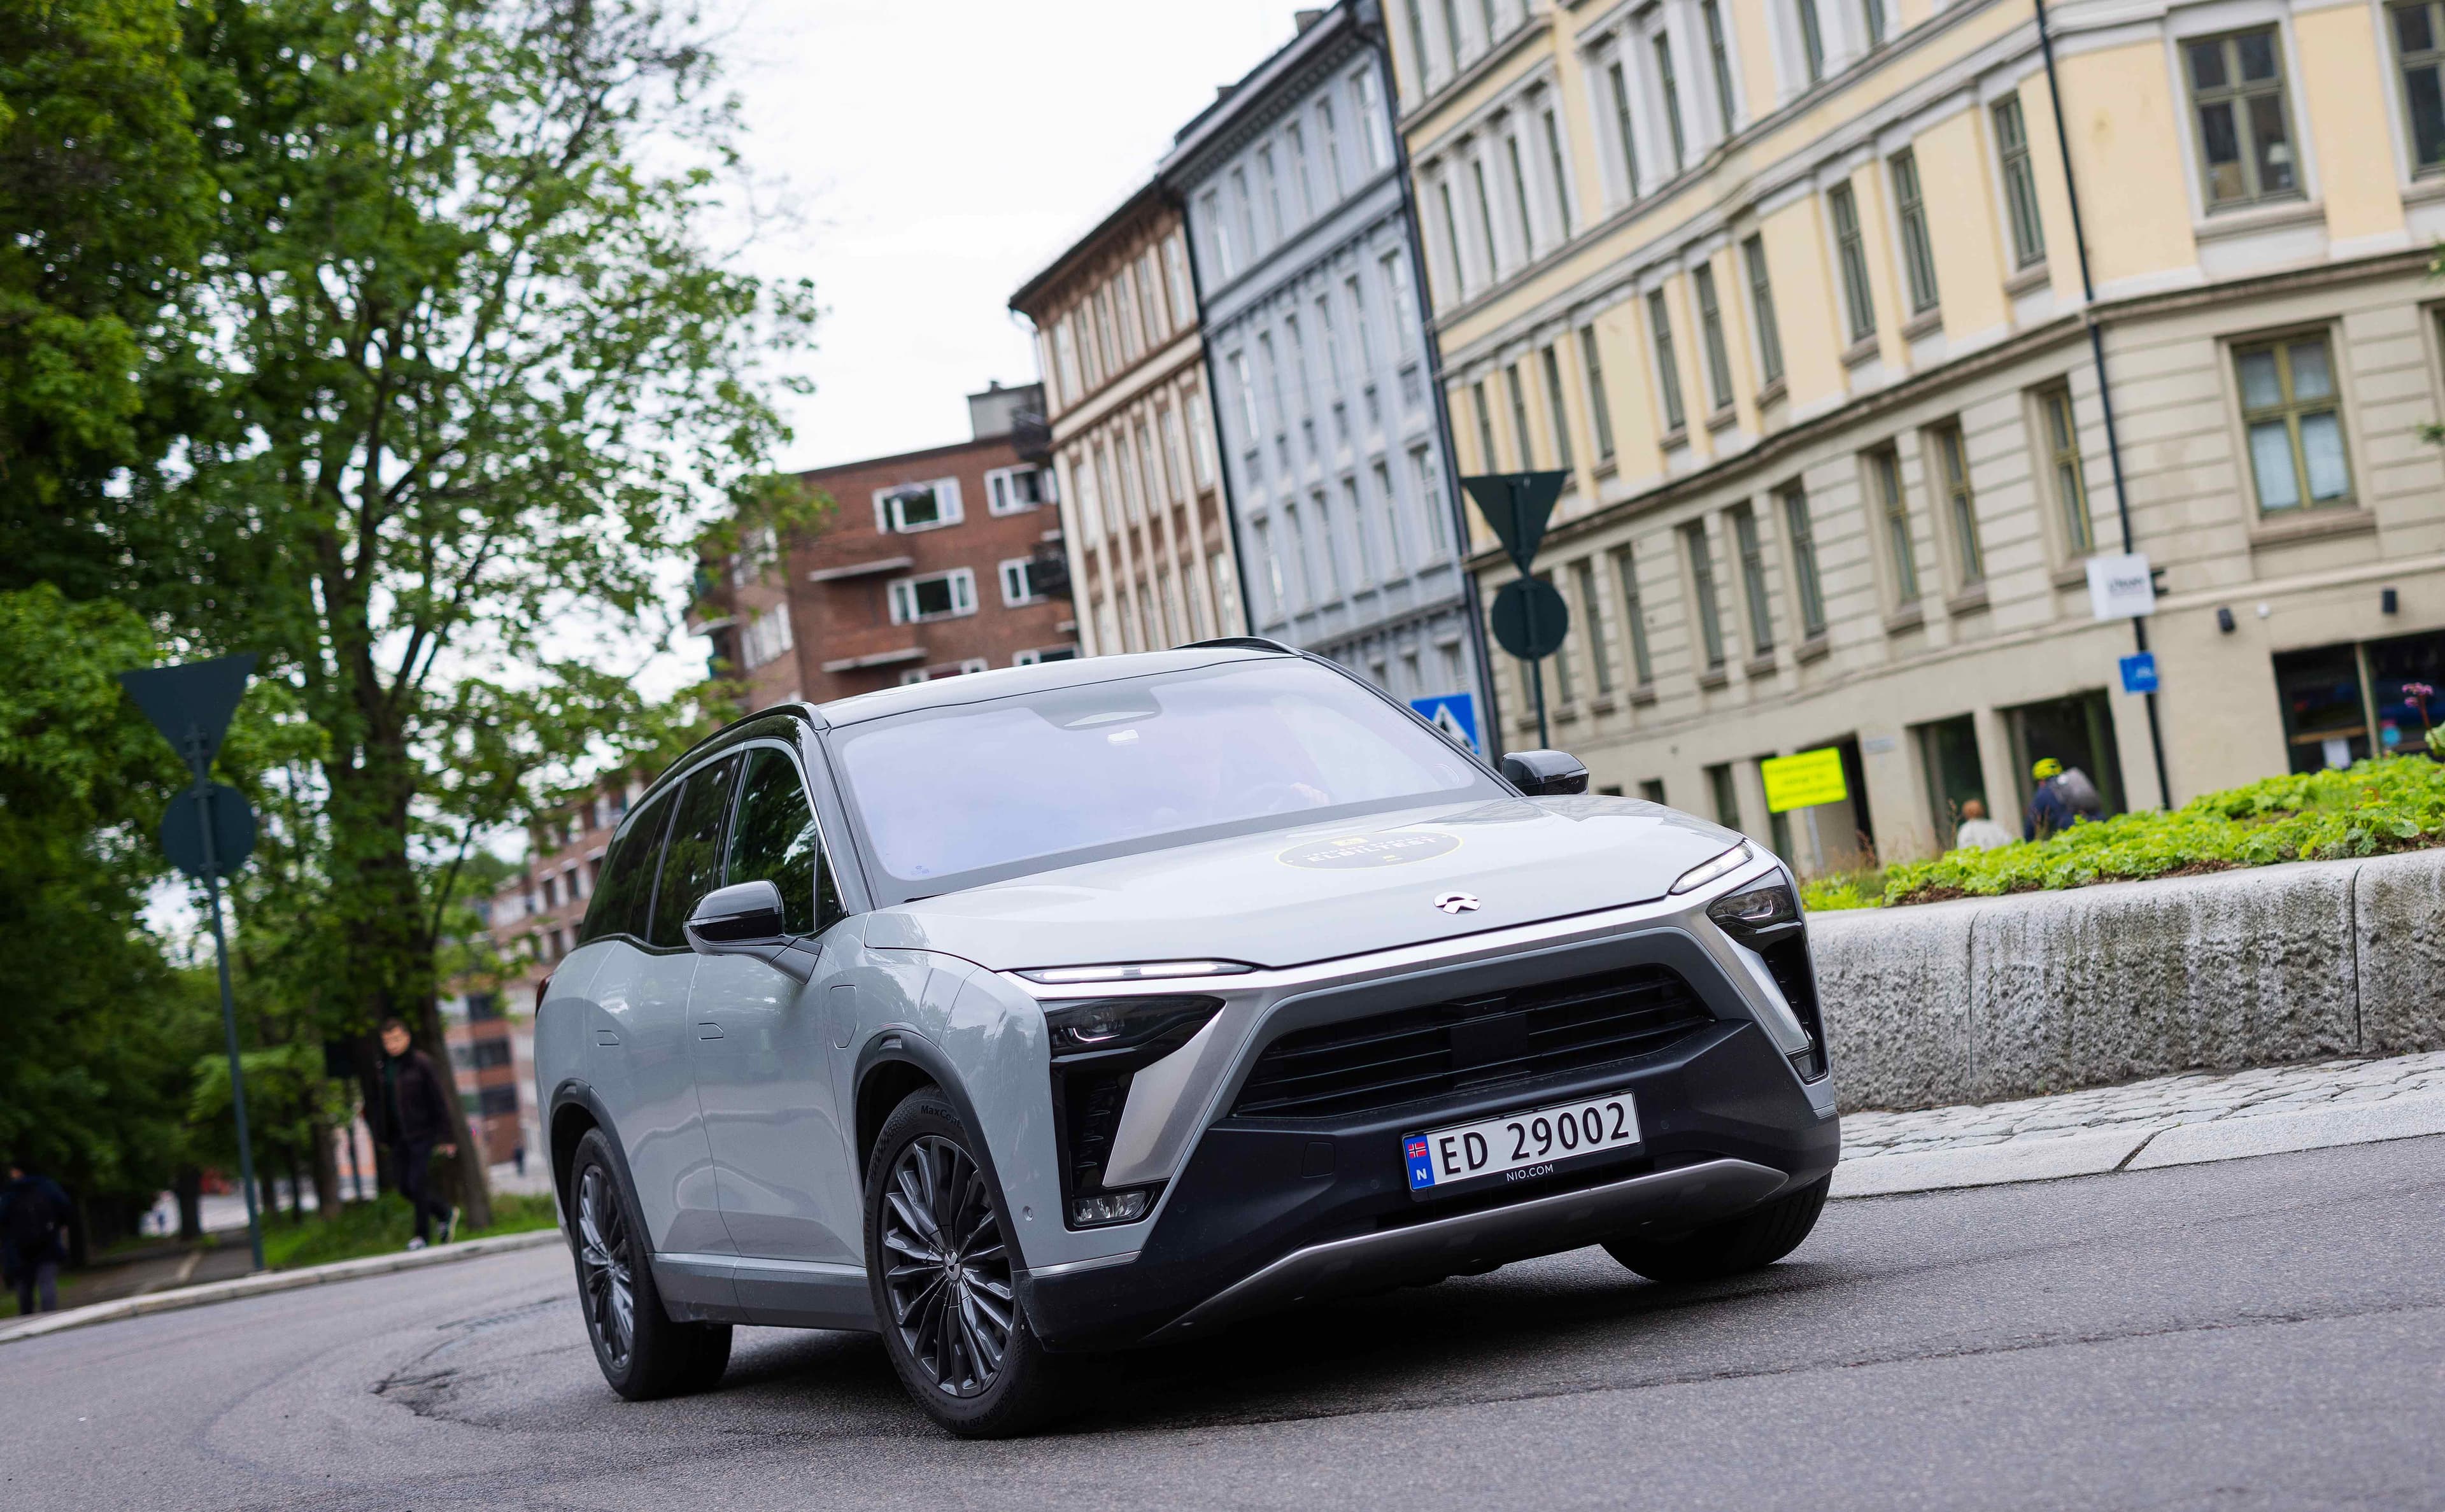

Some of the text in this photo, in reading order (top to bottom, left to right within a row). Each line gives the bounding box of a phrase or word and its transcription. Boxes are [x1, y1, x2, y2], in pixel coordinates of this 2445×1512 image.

[1307, 838, 1437, 861] ELBILTEST
[921, 1105, 963, 1128] MaxCont
[1439, 1102, 1629, 1176] ED 29002
[1416, 1168, 1428, 1181] N
[1506, 1164, 1554, 1182] NIO.COM
